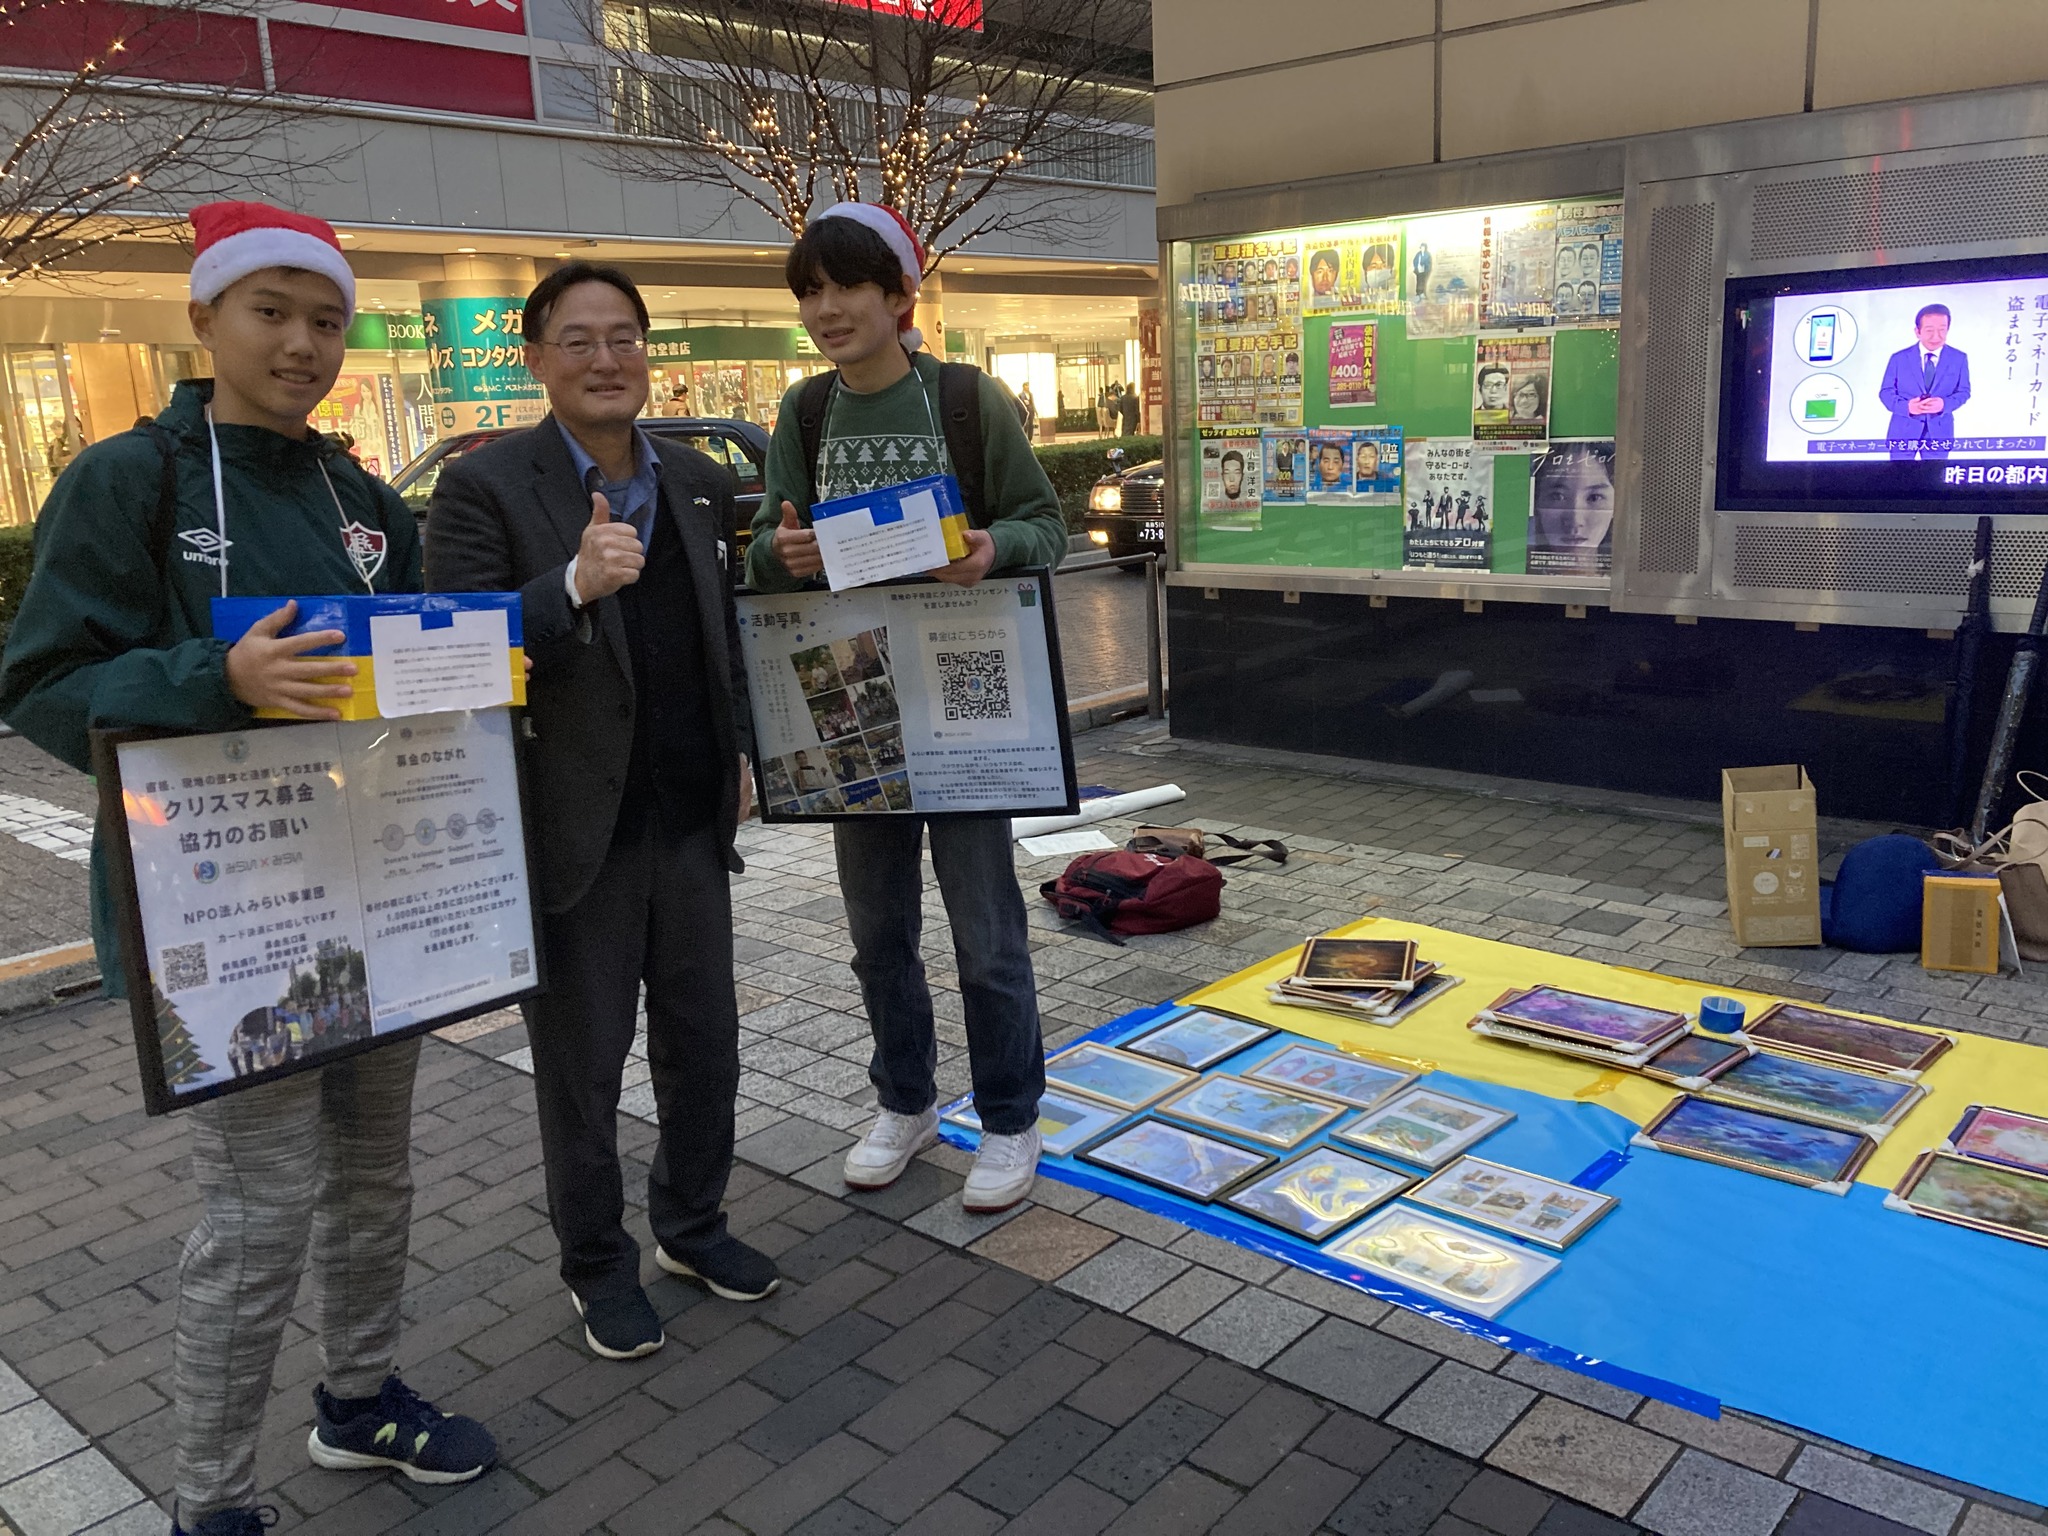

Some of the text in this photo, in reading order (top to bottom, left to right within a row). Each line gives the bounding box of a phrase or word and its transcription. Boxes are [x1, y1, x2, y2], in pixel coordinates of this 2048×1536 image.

[1213, 239, 1298, 261] 重要指名手配
[388, 324, 425, 339] BOOK
[472, 308, 524, 336] メガ
[1214, 333, 1298, 354] 重要指名手配
[475, 404, 512, 428] 2F
[1427, 449, 1471, 458] みんなの街を
[1816, 439, 2037, 452] 電子マネーカードを購入させられてしまったり
[1246, 450, 1256, 498] 小暮洋史
[1426, 461, 1473, 470] 守るヒーローは、
[1945, 465, 2048, 485] 昨日の都内
[183, 550, 229, 566] umbro
[751, 612, 802, 628] 活動写真
[929, 629, 1007, 643] 募金はこちらから
[397, 748, 466, 768] 募金のながれ
[165, 783, 315, 821] クリスマス募金
[178, 817, 309, 854] 協力のお願い
[183, 886, 326, 925] NPO法人みらい事業団
